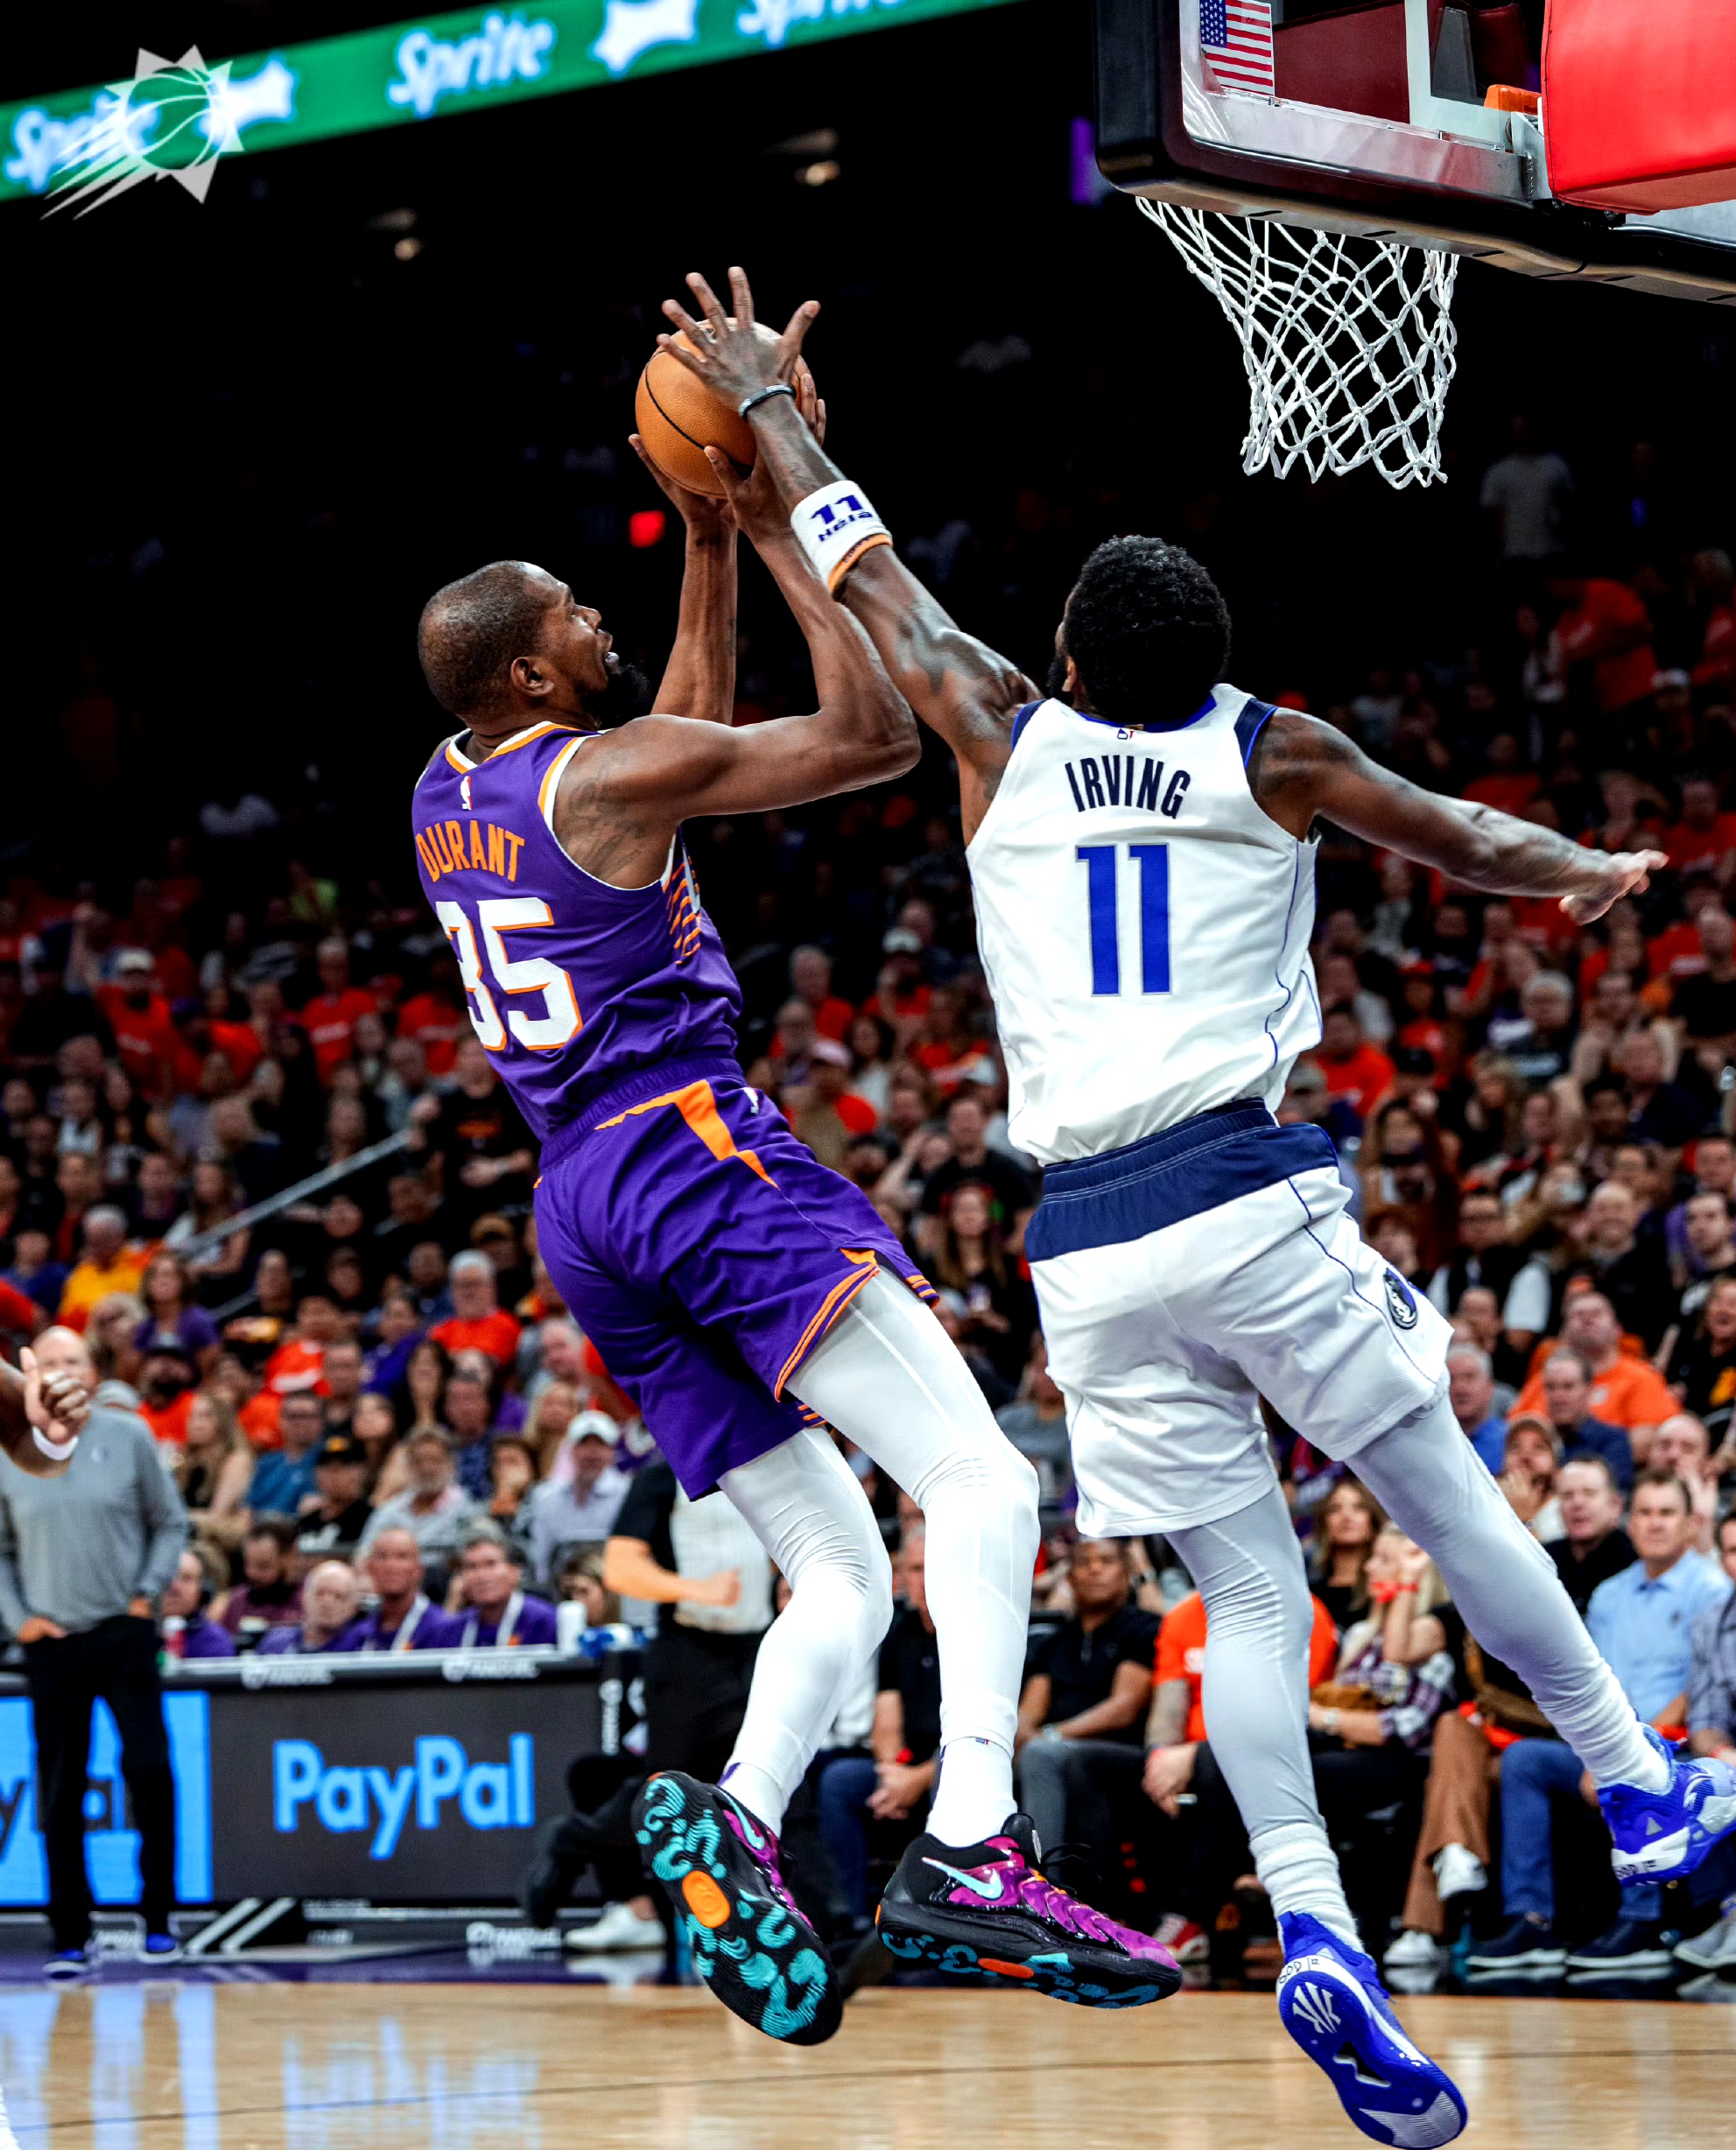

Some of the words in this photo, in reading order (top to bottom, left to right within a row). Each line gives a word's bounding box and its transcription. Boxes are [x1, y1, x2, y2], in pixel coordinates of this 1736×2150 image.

[386, 15, 555, 116] Sprite
[811, 495, 862, 525] 11
[1065, 755, 1191, 819] IRVING
[415, 820, 525, 882] DURANT
[1075, 842, 1172, 997] 11
[435, 897, 584, 1050] 35
[273, 1732, 535, 1859] PayPal
